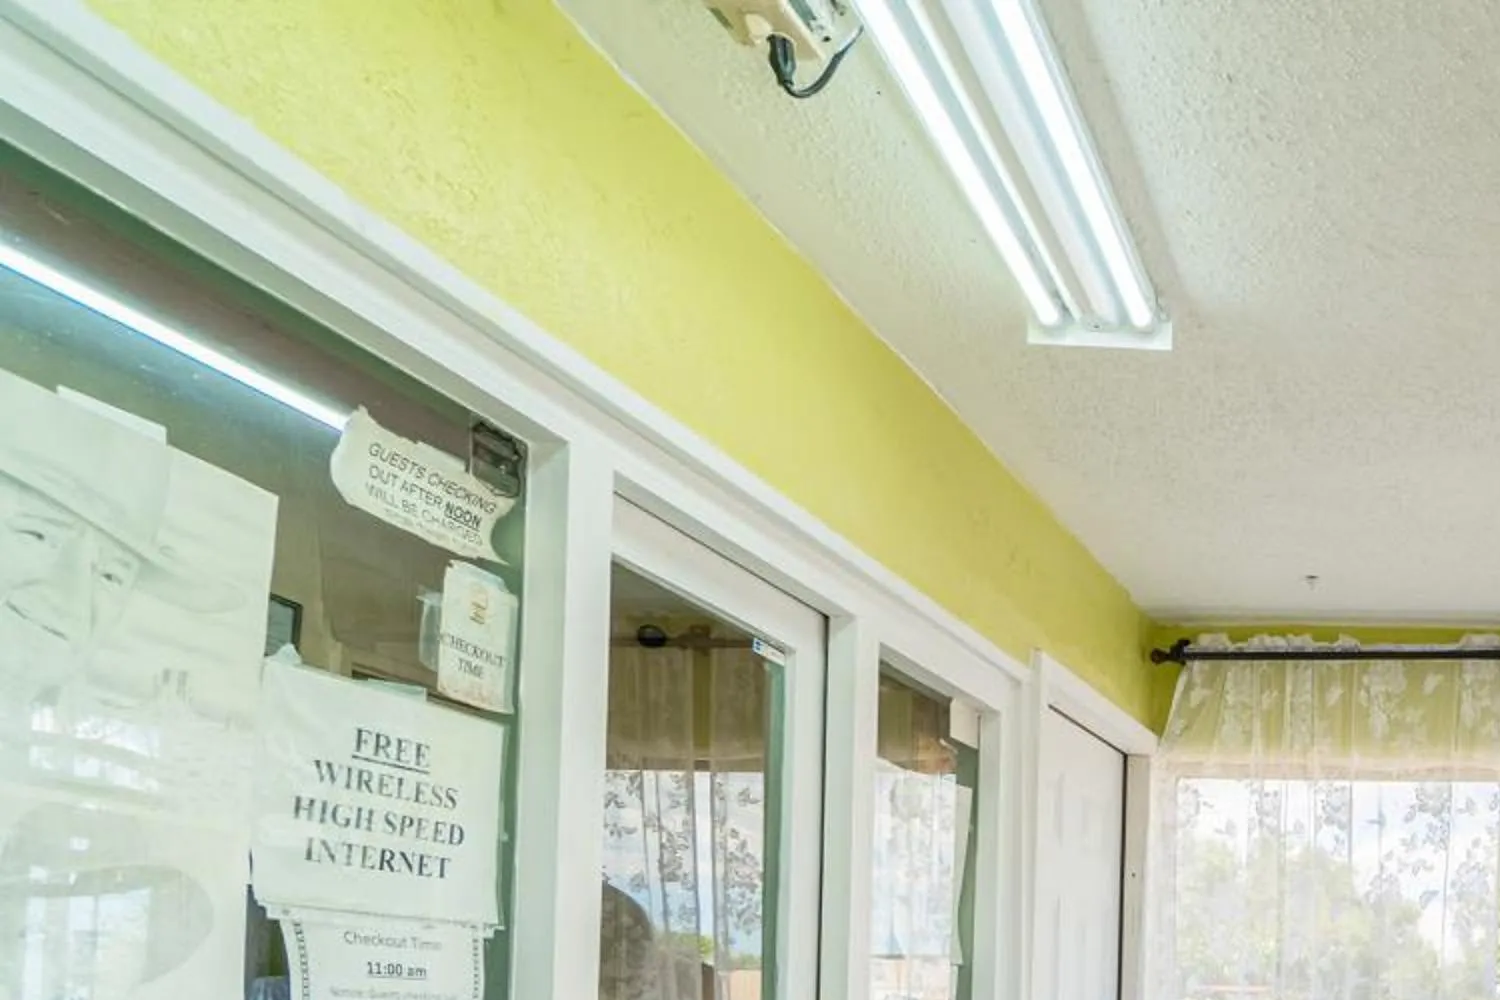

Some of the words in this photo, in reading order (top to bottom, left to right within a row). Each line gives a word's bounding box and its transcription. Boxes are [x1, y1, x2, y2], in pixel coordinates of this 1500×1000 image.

[365, 480, 399, 509] WILL
[401, 499, 419, 517] BE
[369, 442, 427, 480] GUESTS
[427, 471, 497, 515] CHECKING
[369, 465, 398, 489] OUT
[400, 479, 443, 508] AFTER
[444, 502, 482, 531] NOON
[438, 632, 506, 668] CHECKOUT
[457, 657, 485, 679] TIME
[353, 727, 431, 773] FREE
[313, 759, 460, 810] WIRELESS
[293, 795, 375, 832] HIGH
[383, 811, 465, 847] SPEED
[304, 837, 452, 879] INTERNET
[343, 931, 407, 949] Checkout
[366, 961, 403, 978] 11:00
[405, 966, 428, 980] am
